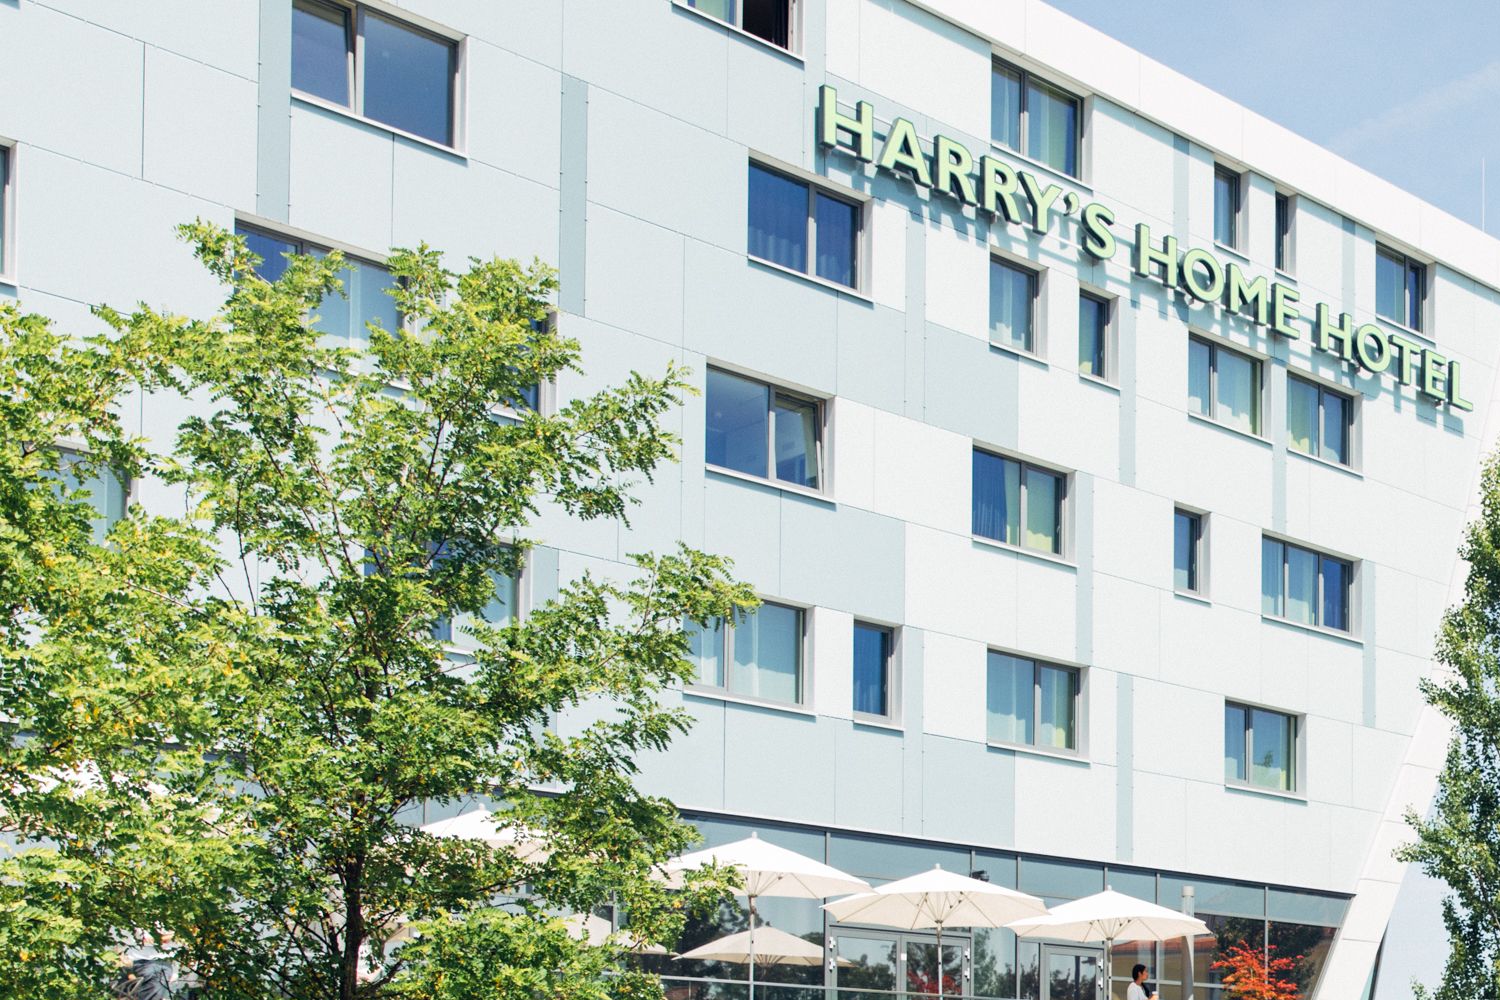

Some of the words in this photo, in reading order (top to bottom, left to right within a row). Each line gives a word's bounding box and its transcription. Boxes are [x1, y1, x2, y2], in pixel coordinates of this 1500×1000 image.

[819, 85, 1117, 260] HARRY'S
[1135, 223, 1300, 340] HOME
[1316, 303, 1474, 412] HOTEL
